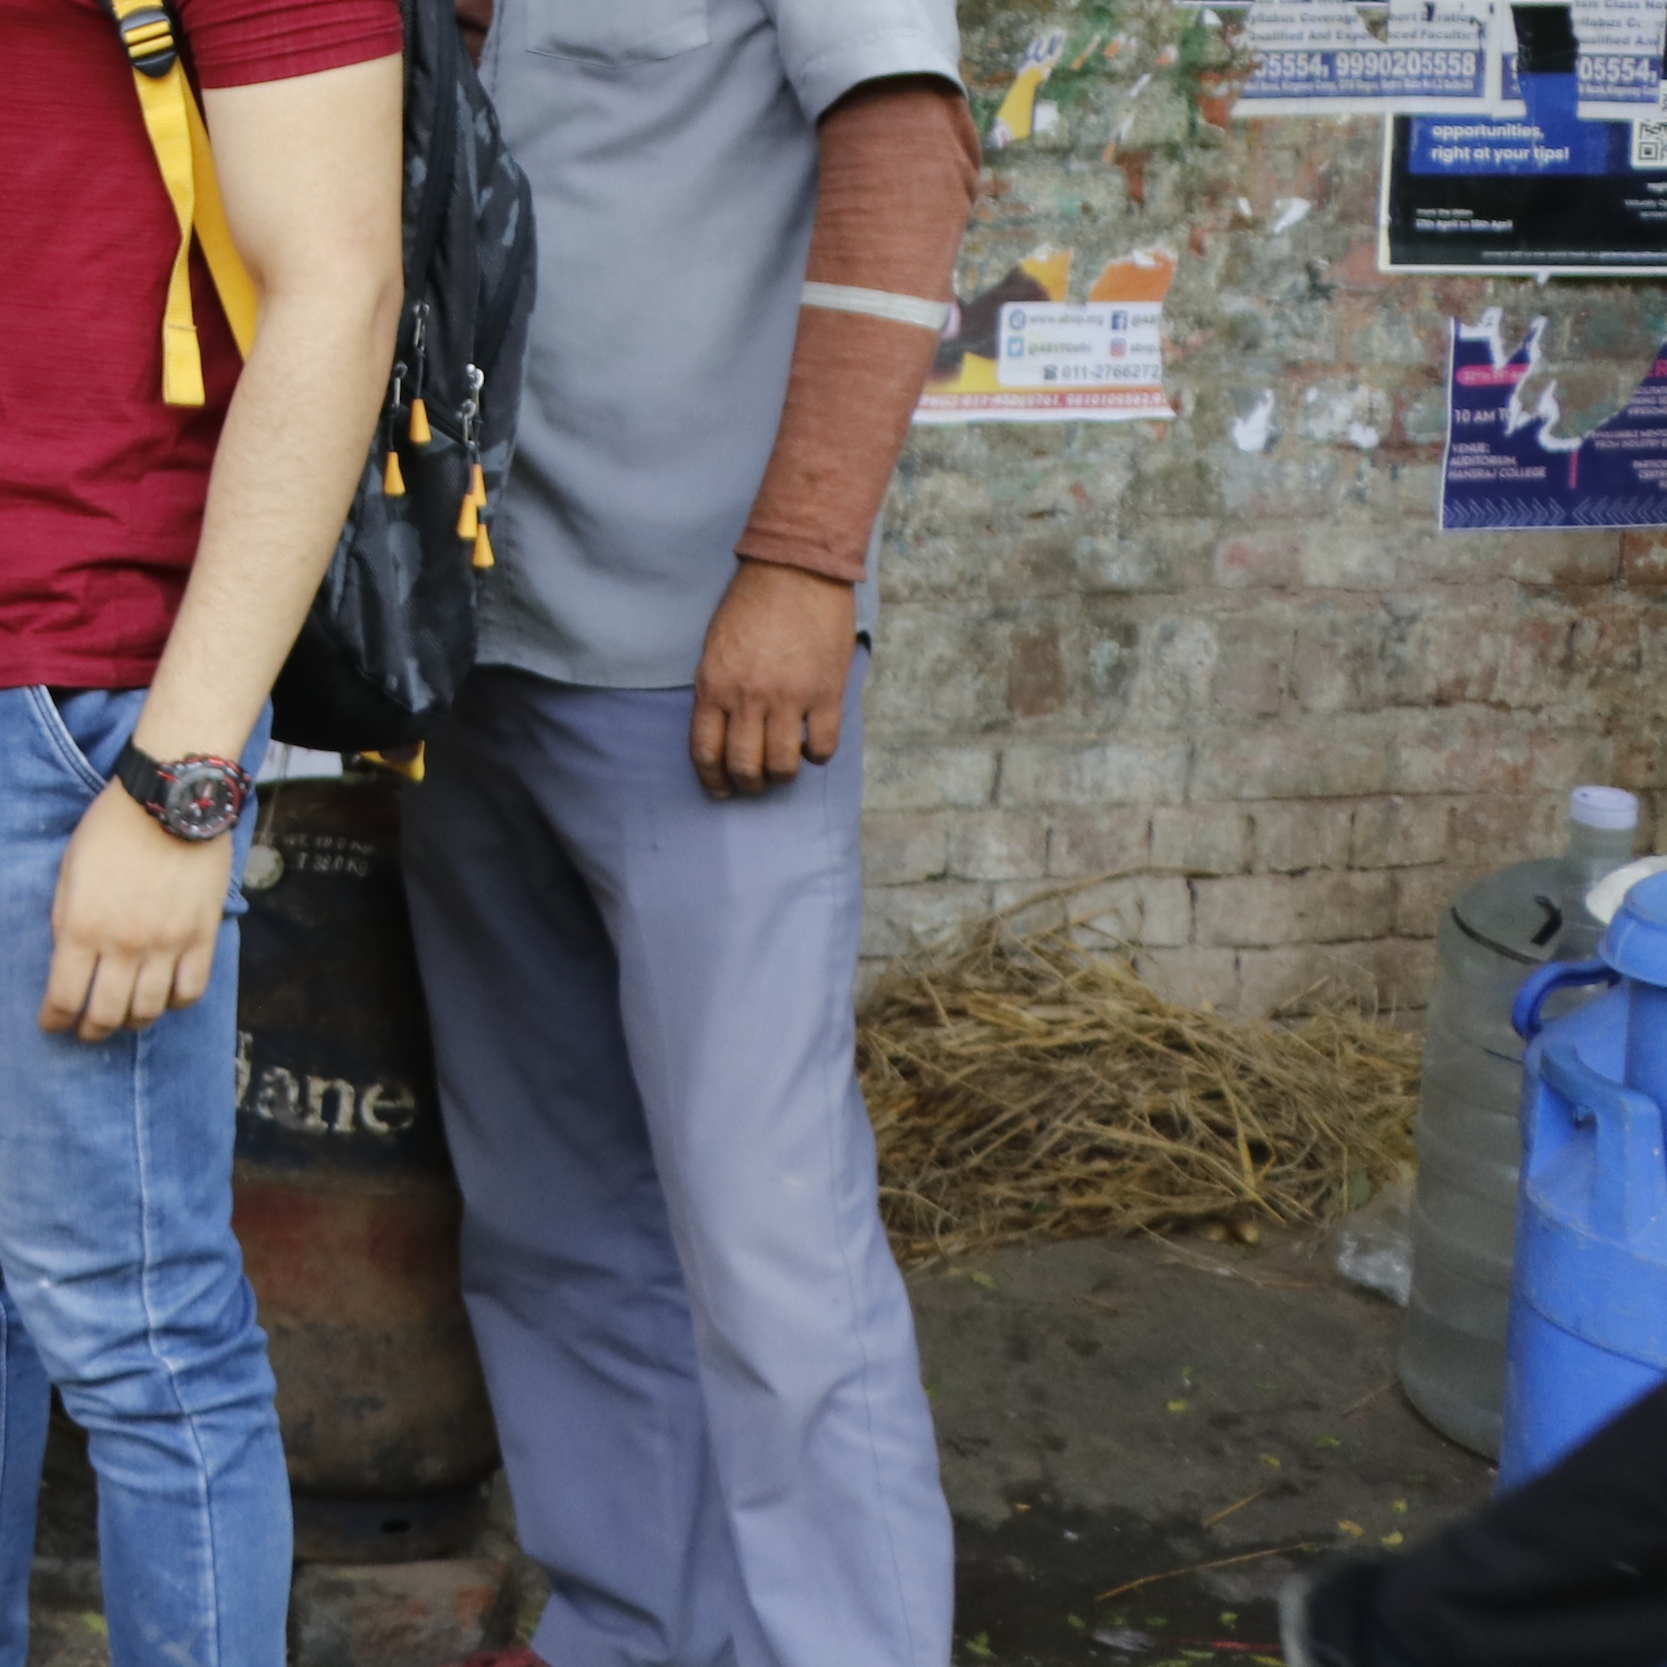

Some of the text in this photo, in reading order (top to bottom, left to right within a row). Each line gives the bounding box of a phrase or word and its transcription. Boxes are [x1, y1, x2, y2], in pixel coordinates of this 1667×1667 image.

[1335, 51, 1476, 77] 9990205558
[1431, 122, 1545, 141] opportunities,
[1431, 145, 1570, 165] right at your tips!
